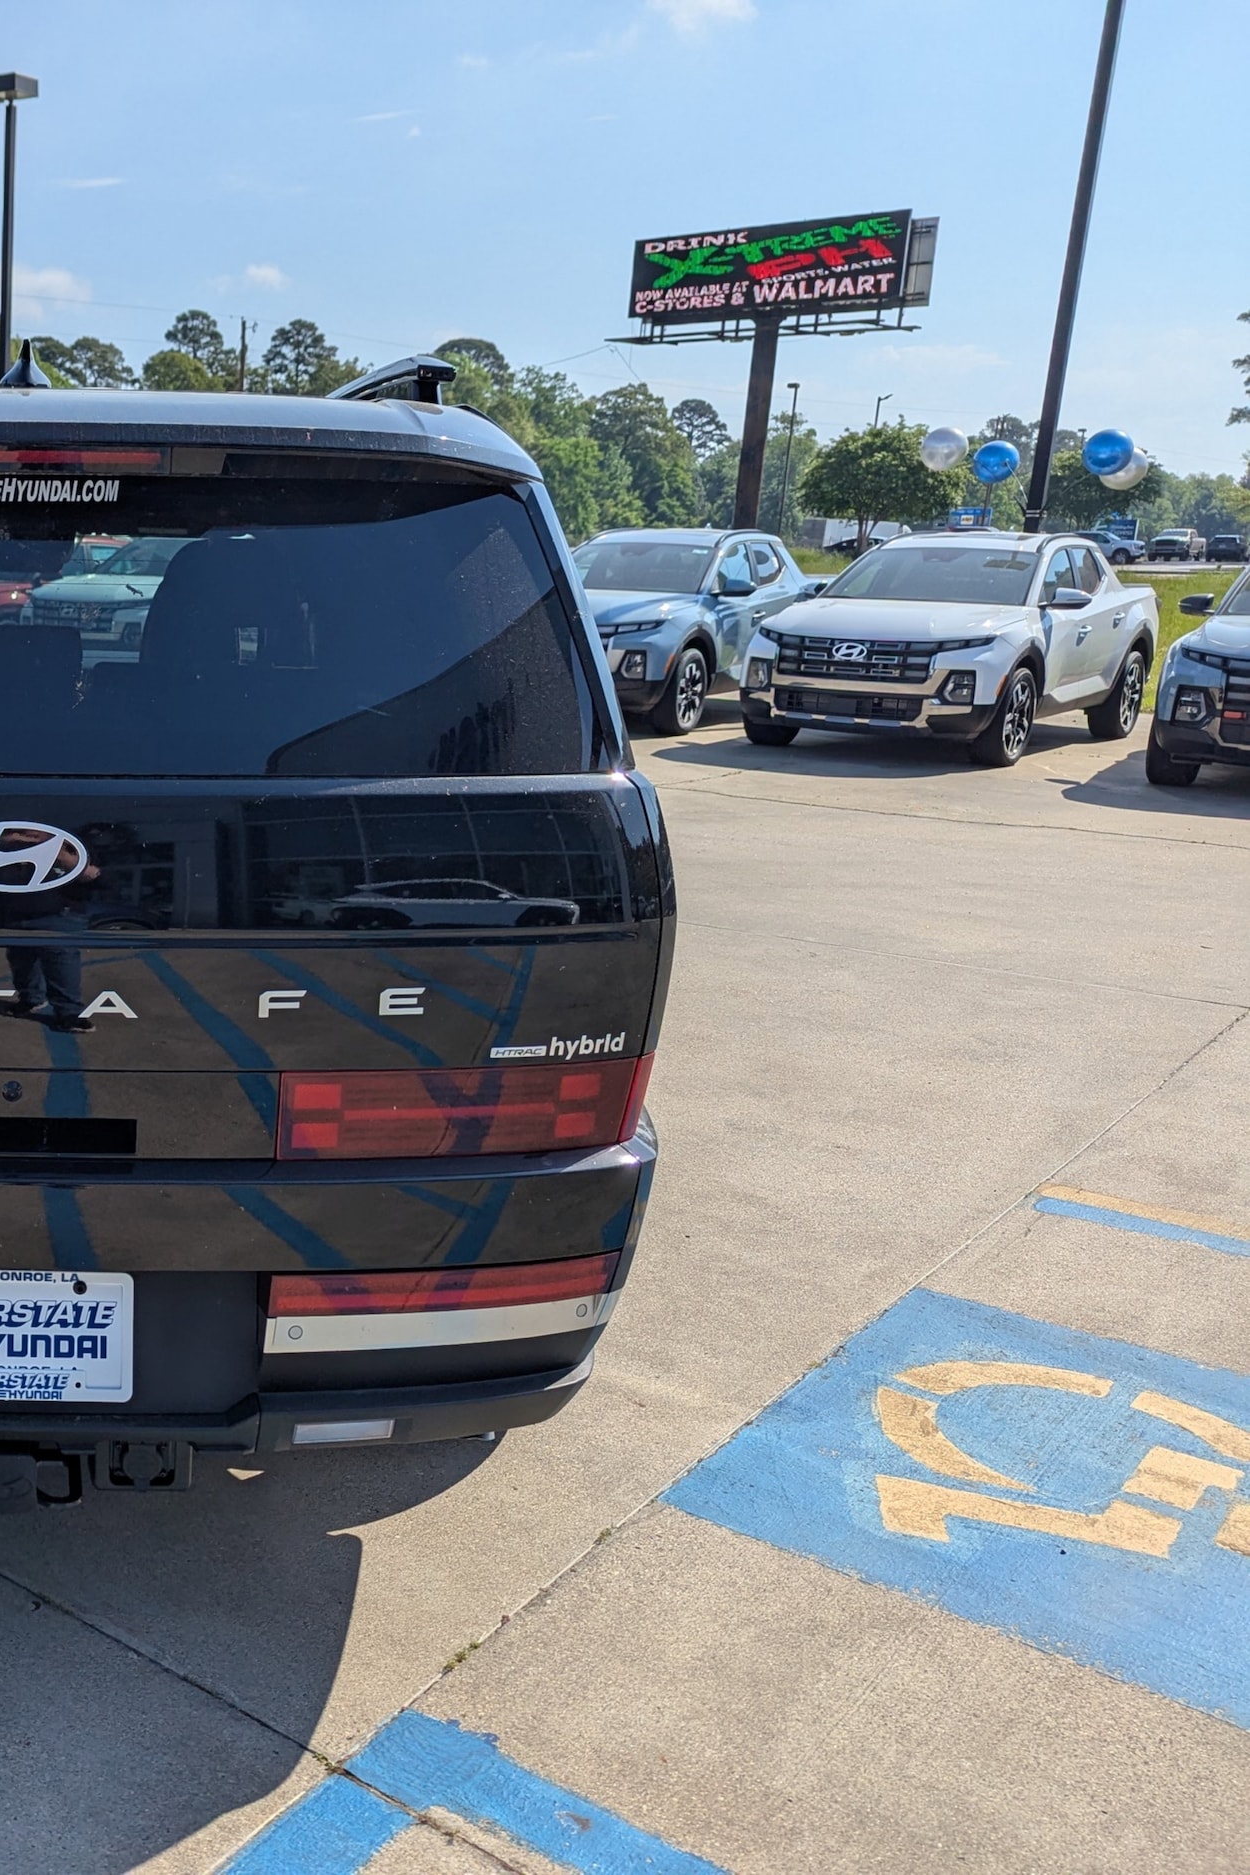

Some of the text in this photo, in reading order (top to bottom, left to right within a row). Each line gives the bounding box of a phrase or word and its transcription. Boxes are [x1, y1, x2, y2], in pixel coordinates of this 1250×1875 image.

[644, 231, 748, 254] DRINK
[635, 281, 749, 301] NOW AVAILABLE AT
[635, 294, 726, 314] C-STORES
[730, 293, 745, 305] &
[753, 273, 895, 304] WALMART
[258, 987, 426, 1018] FE
[494, 1032, 626, 1060] HTRAC hybrid
[61, 1273, 80, 1282] LA
[8, 1389, 62, 1400] HYUNDAI
